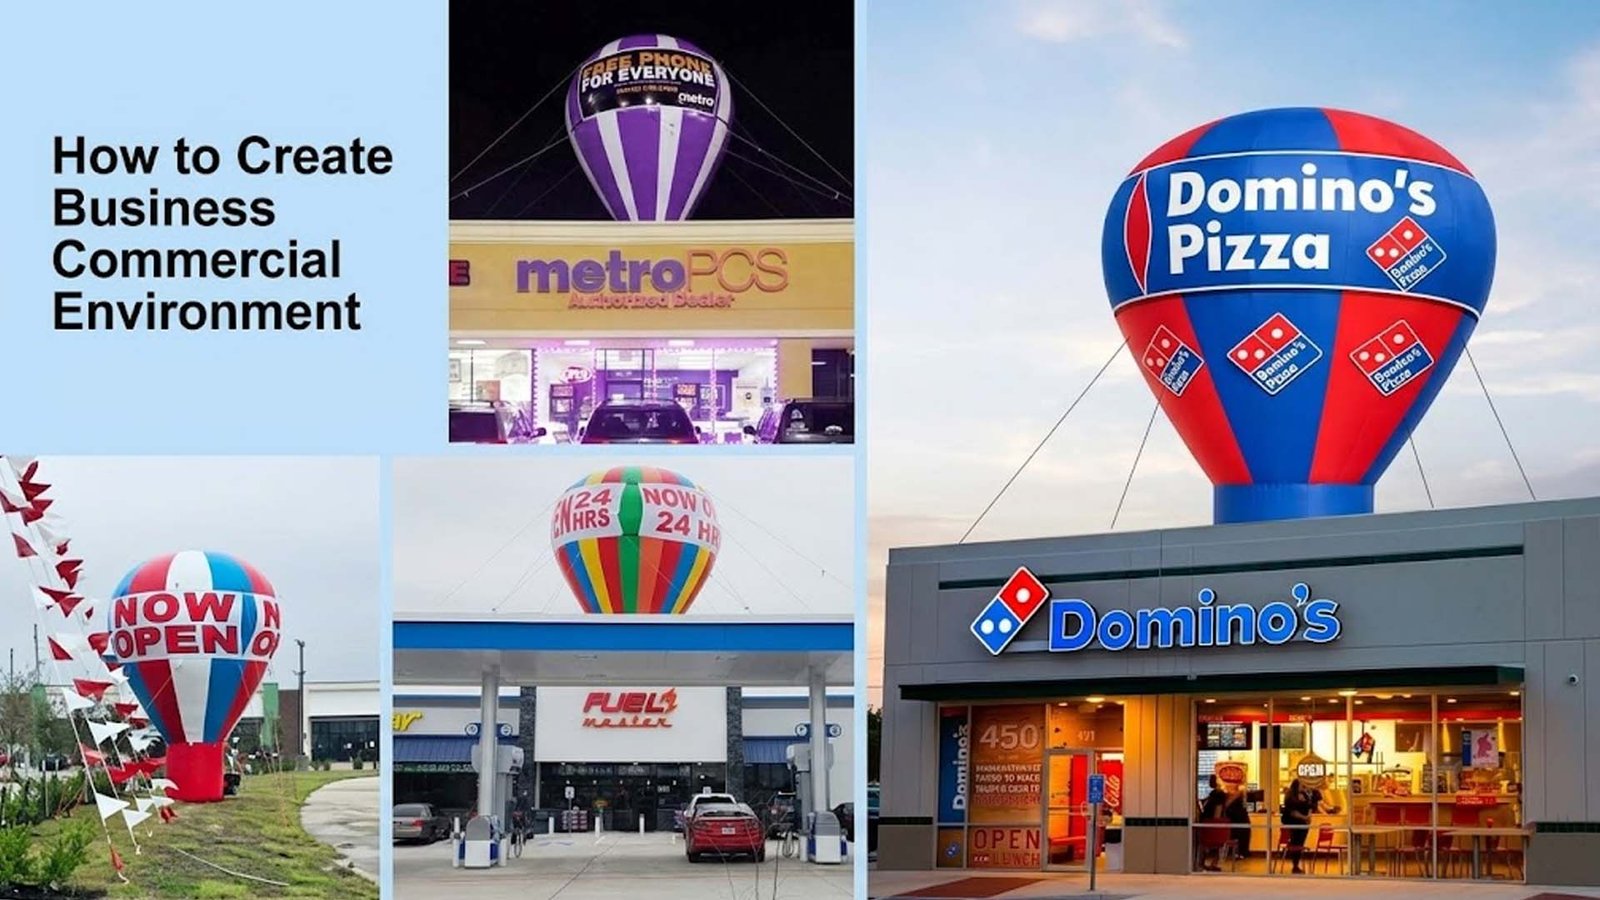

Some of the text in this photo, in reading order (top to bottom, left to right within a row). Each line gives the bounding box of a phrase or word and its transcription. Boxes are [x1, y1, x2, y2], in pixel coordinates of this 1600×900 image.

[581, 52, 712, 79] FREE PHONE
[581, 72, 614, 94] FOR
[618, 66, 716, 88] EVERYONE
[678, 92, 715, 107] metro
[1165, 162, 1438, 217] Domino's
[1168, 220, 1331, 275] Pizza
[516, 248, 790, 294] metroPCS
[567, 291, 735, 309] Authorized Dealer
[574, 489, 613, 510] 24
[642, 487, 698, 513] NOW
[572, 508, 611, 532] HRS
[655, 510, 692, 536] 24
[114, 593, 236, 628] NOW
[1048, 583, 1342, 652] Domino's
[113, 625, 281, 659] OPEN O
[582, 692, 665, 714] FUEL
[582, 715, 672, 728] master
[979, 724, 1039, 749] 450
[952, 724, 970, 811] Domino's
[974, 829, 1040, 850] OPEN
